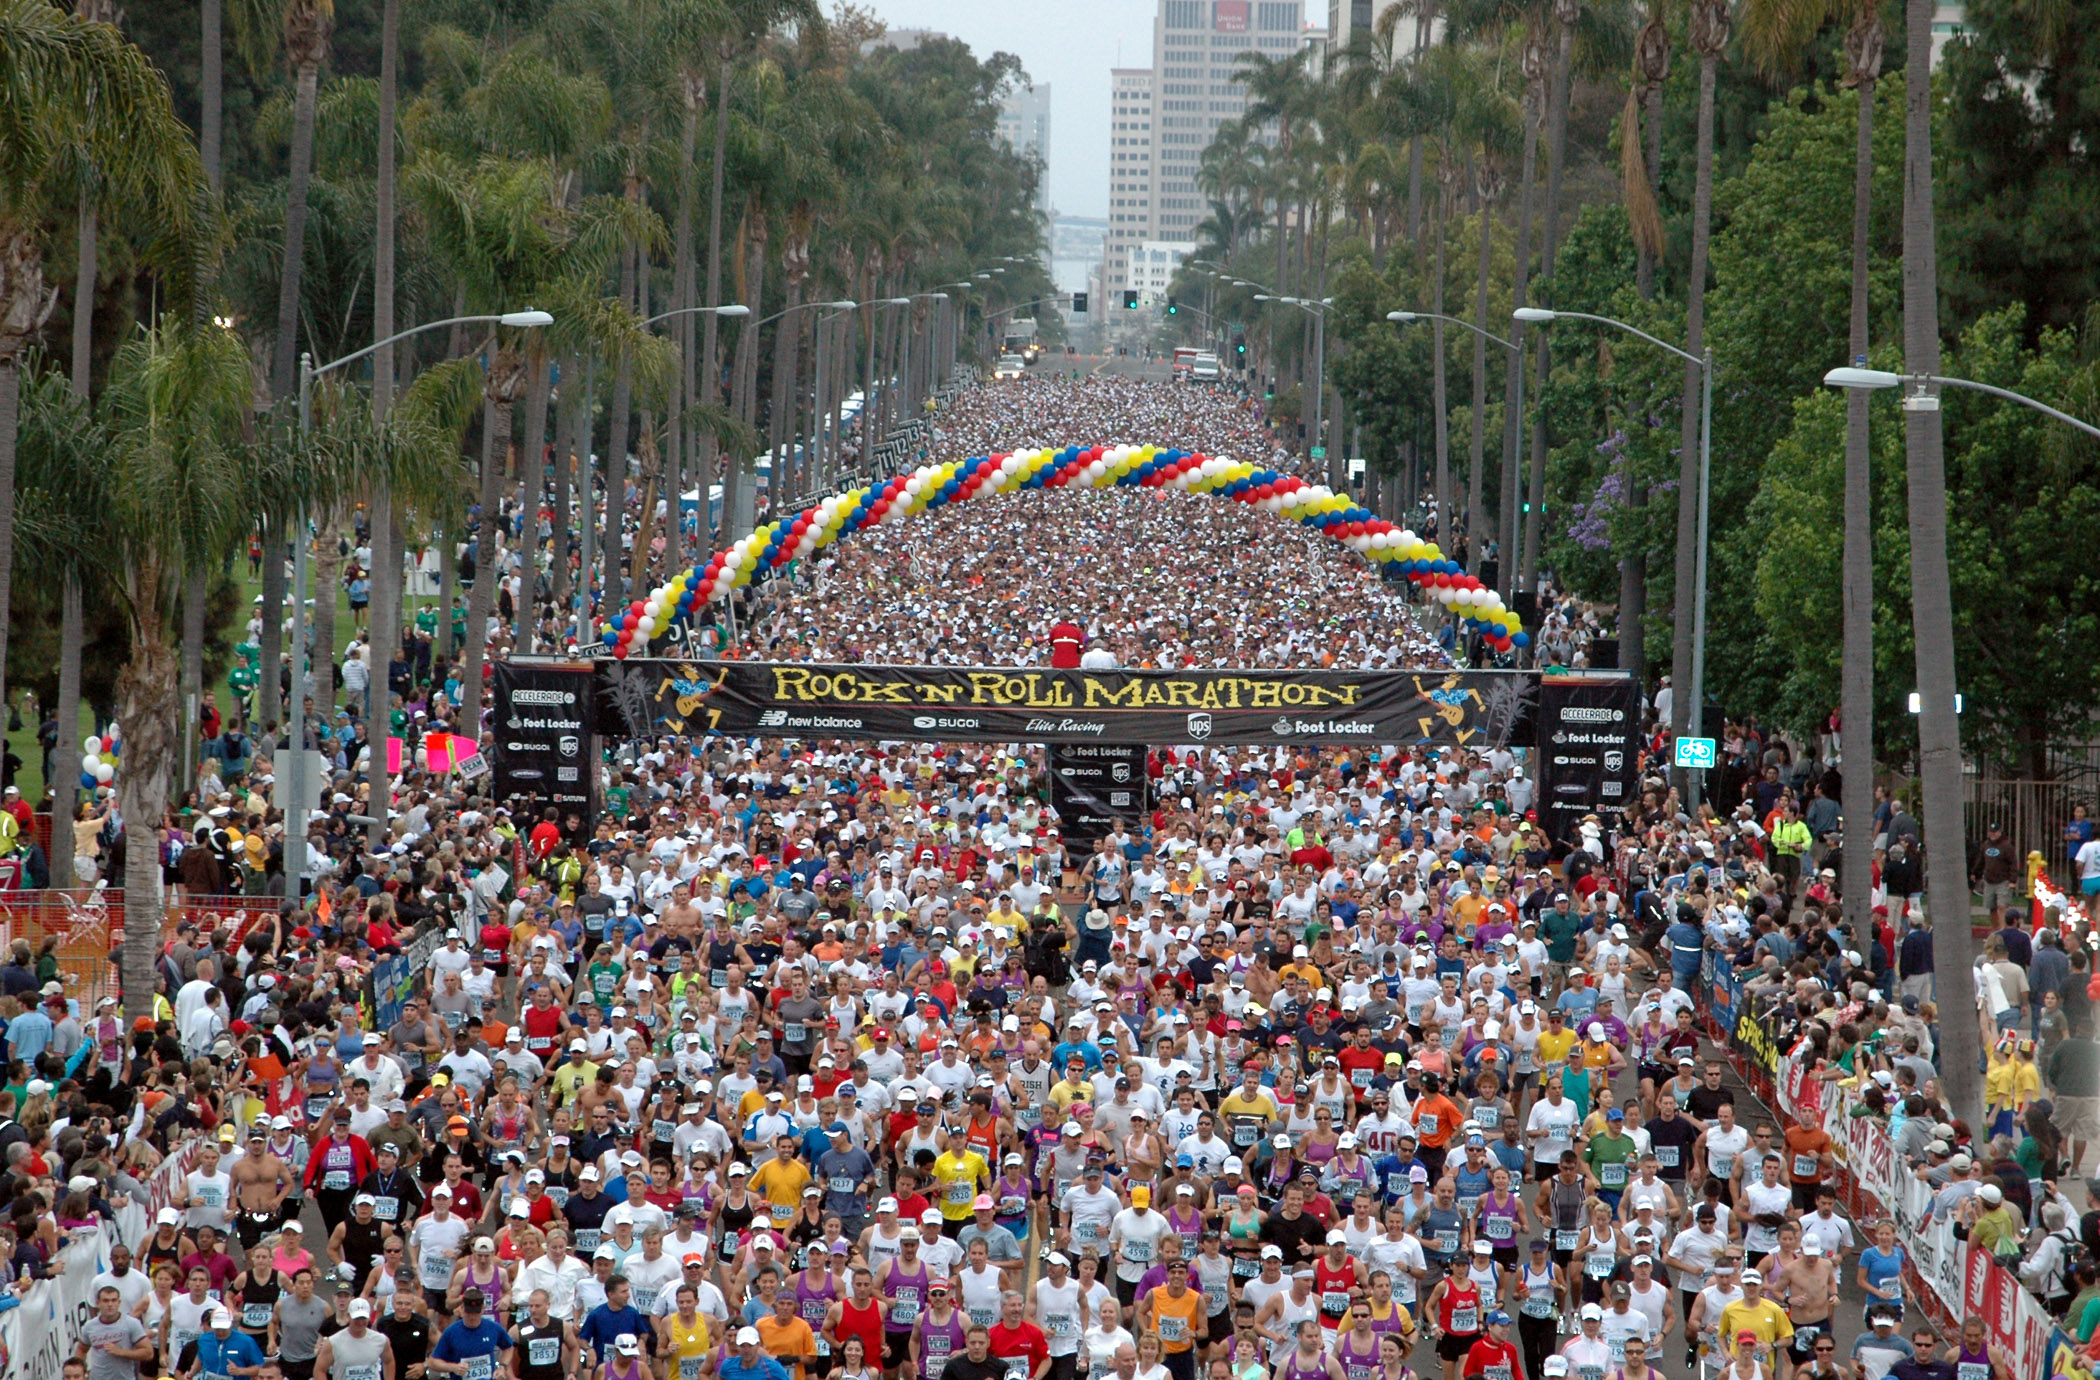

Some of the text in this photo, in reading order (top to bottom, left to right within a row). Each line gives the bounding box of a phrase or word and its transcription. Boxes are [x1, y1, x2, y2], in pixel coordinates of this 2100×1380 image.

[512, 690, 564, 703] ACCELERADE
[1083, 678, 1360, 709] MARATHON
[1561, 708, 1612, 721] ACCELERADE
[523, 718, 581, 729] Foot Locker
[788, 718, 812, 728] new
[814, 716, 862, 728] balance
[1025, 718, 1105, 735] Elite Racing
[1295, 720, 1375, 734] Foot Locker
[1568, 733, 1626, 744] Foot Locker
[1077, 747, 1132, 756] Foot Locker
[463, 759, 483, 773] TEAM
[1022, 1080, 1042, 1089] RISH
[1179, 1122, 1194, 1131] 20
[832, 1179, 850, 1187] 4237
[1390, 1182, 1409, 1190] 5397
[949, 1191, 970, 1200] 5520
[1489, 1226, 1509, 1234] 5573
[578, 1239, 597, 1248] 4261
[1128, 1248, 1149, 1257] 4598
[426, 1264, 447, 1274] 9696
[804, 1307, 825, 1315] TEAM
[894, 1309, 916, 1319] 4802
[1527, 1304, 1548, 1314] 9959
[1161, 1327, 1179, 1336] 539
[533, 1350, 556, 1360] 3853
[466, 1368, 489, 1378] 2630
